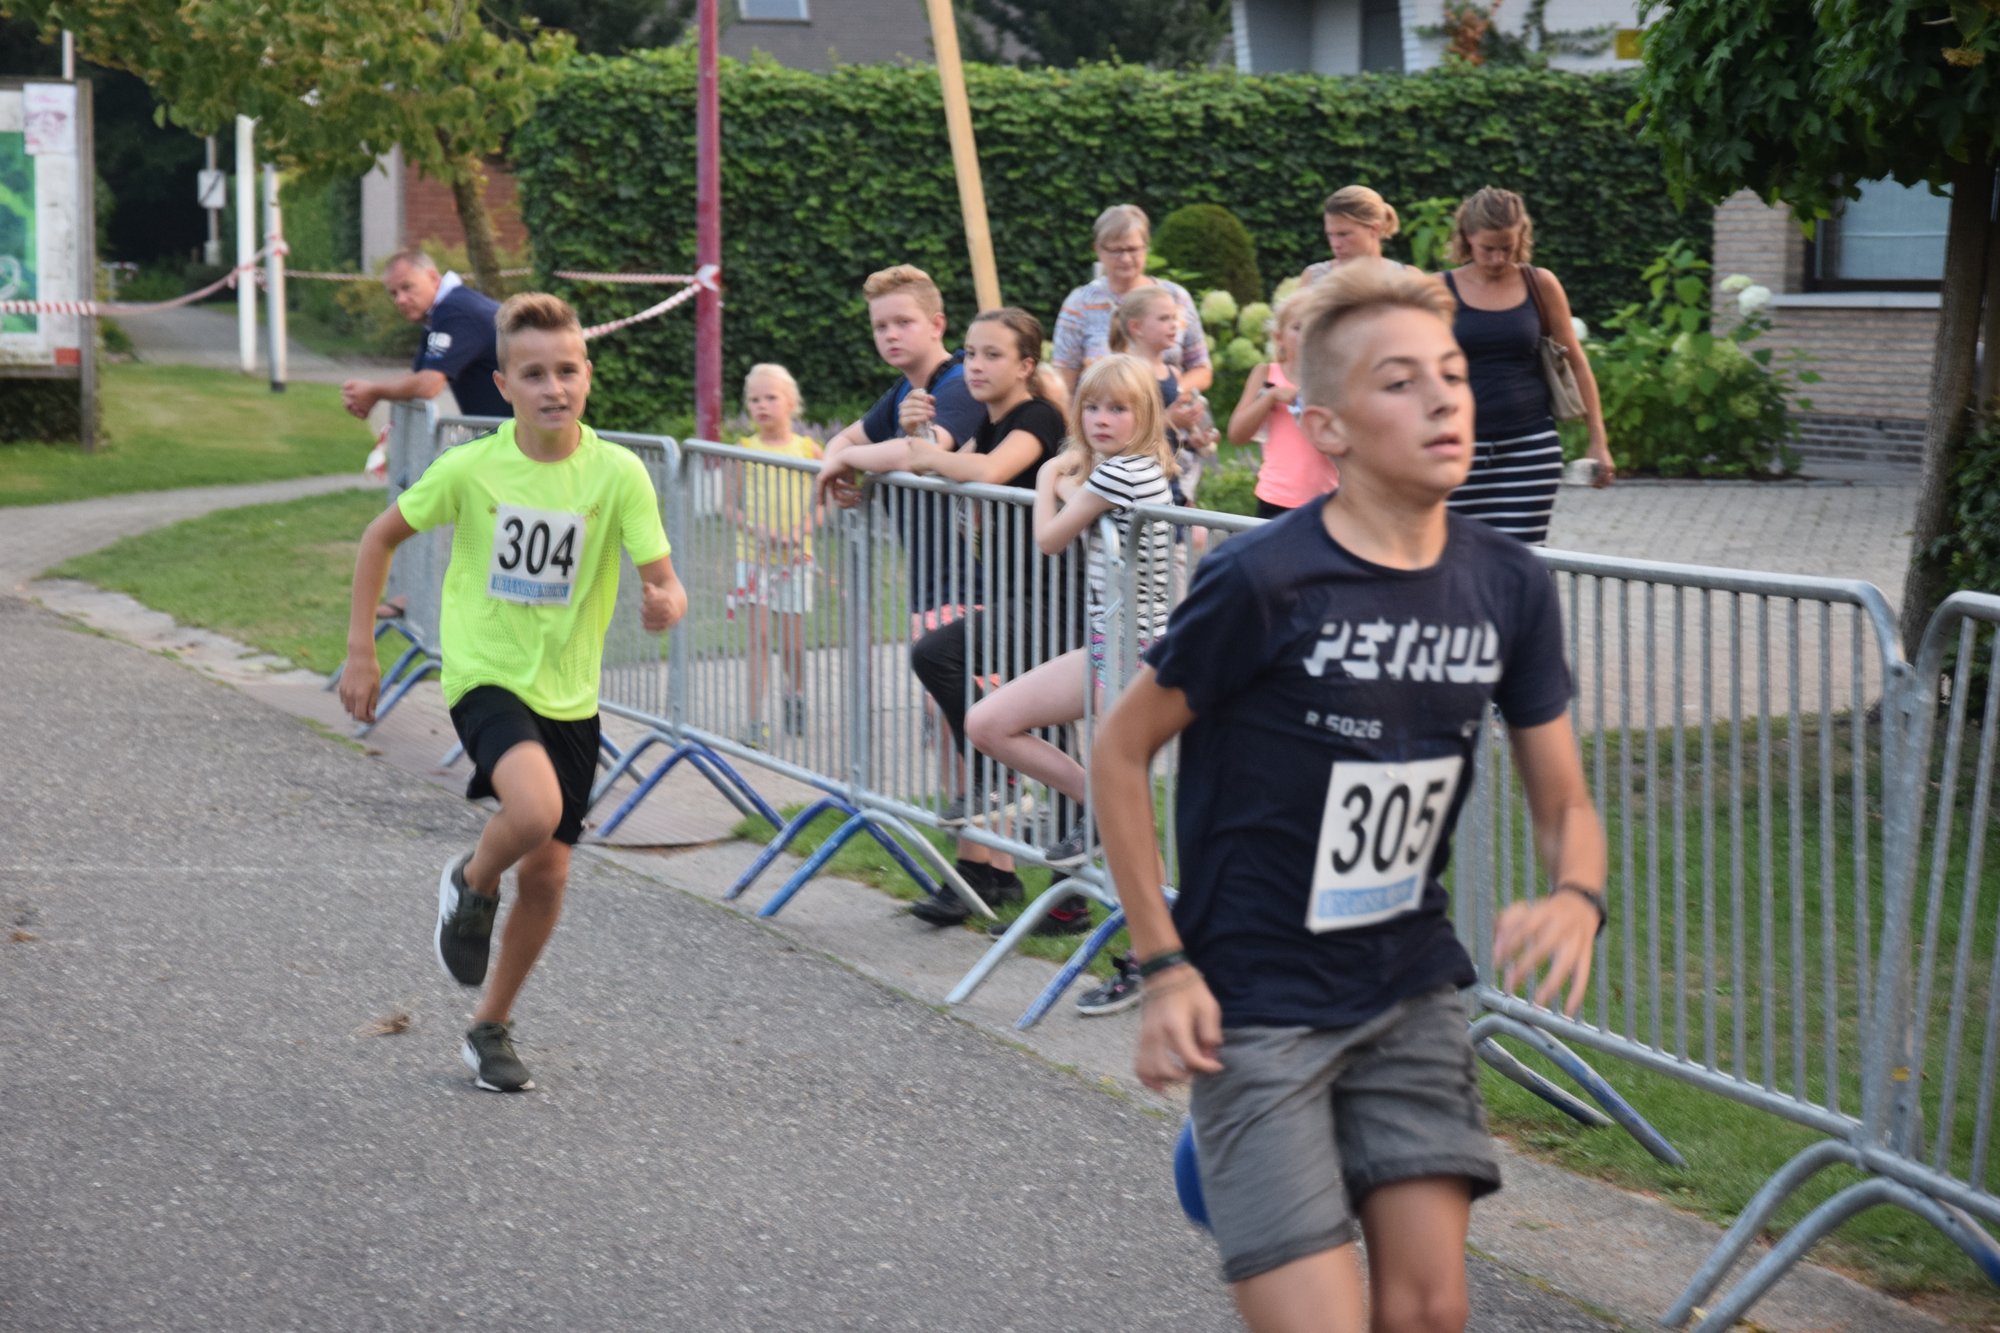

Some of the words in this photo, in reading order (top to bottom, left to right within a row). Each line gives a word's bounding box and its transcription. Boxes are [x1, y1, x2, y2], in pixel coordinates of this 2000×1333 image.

[497, 516, 576, 577] 304
[1302, 616, 1503, 684] PETROL
[1325, 714, 1383, 740] 5026
[1331, 777, 1447, 876] 305
